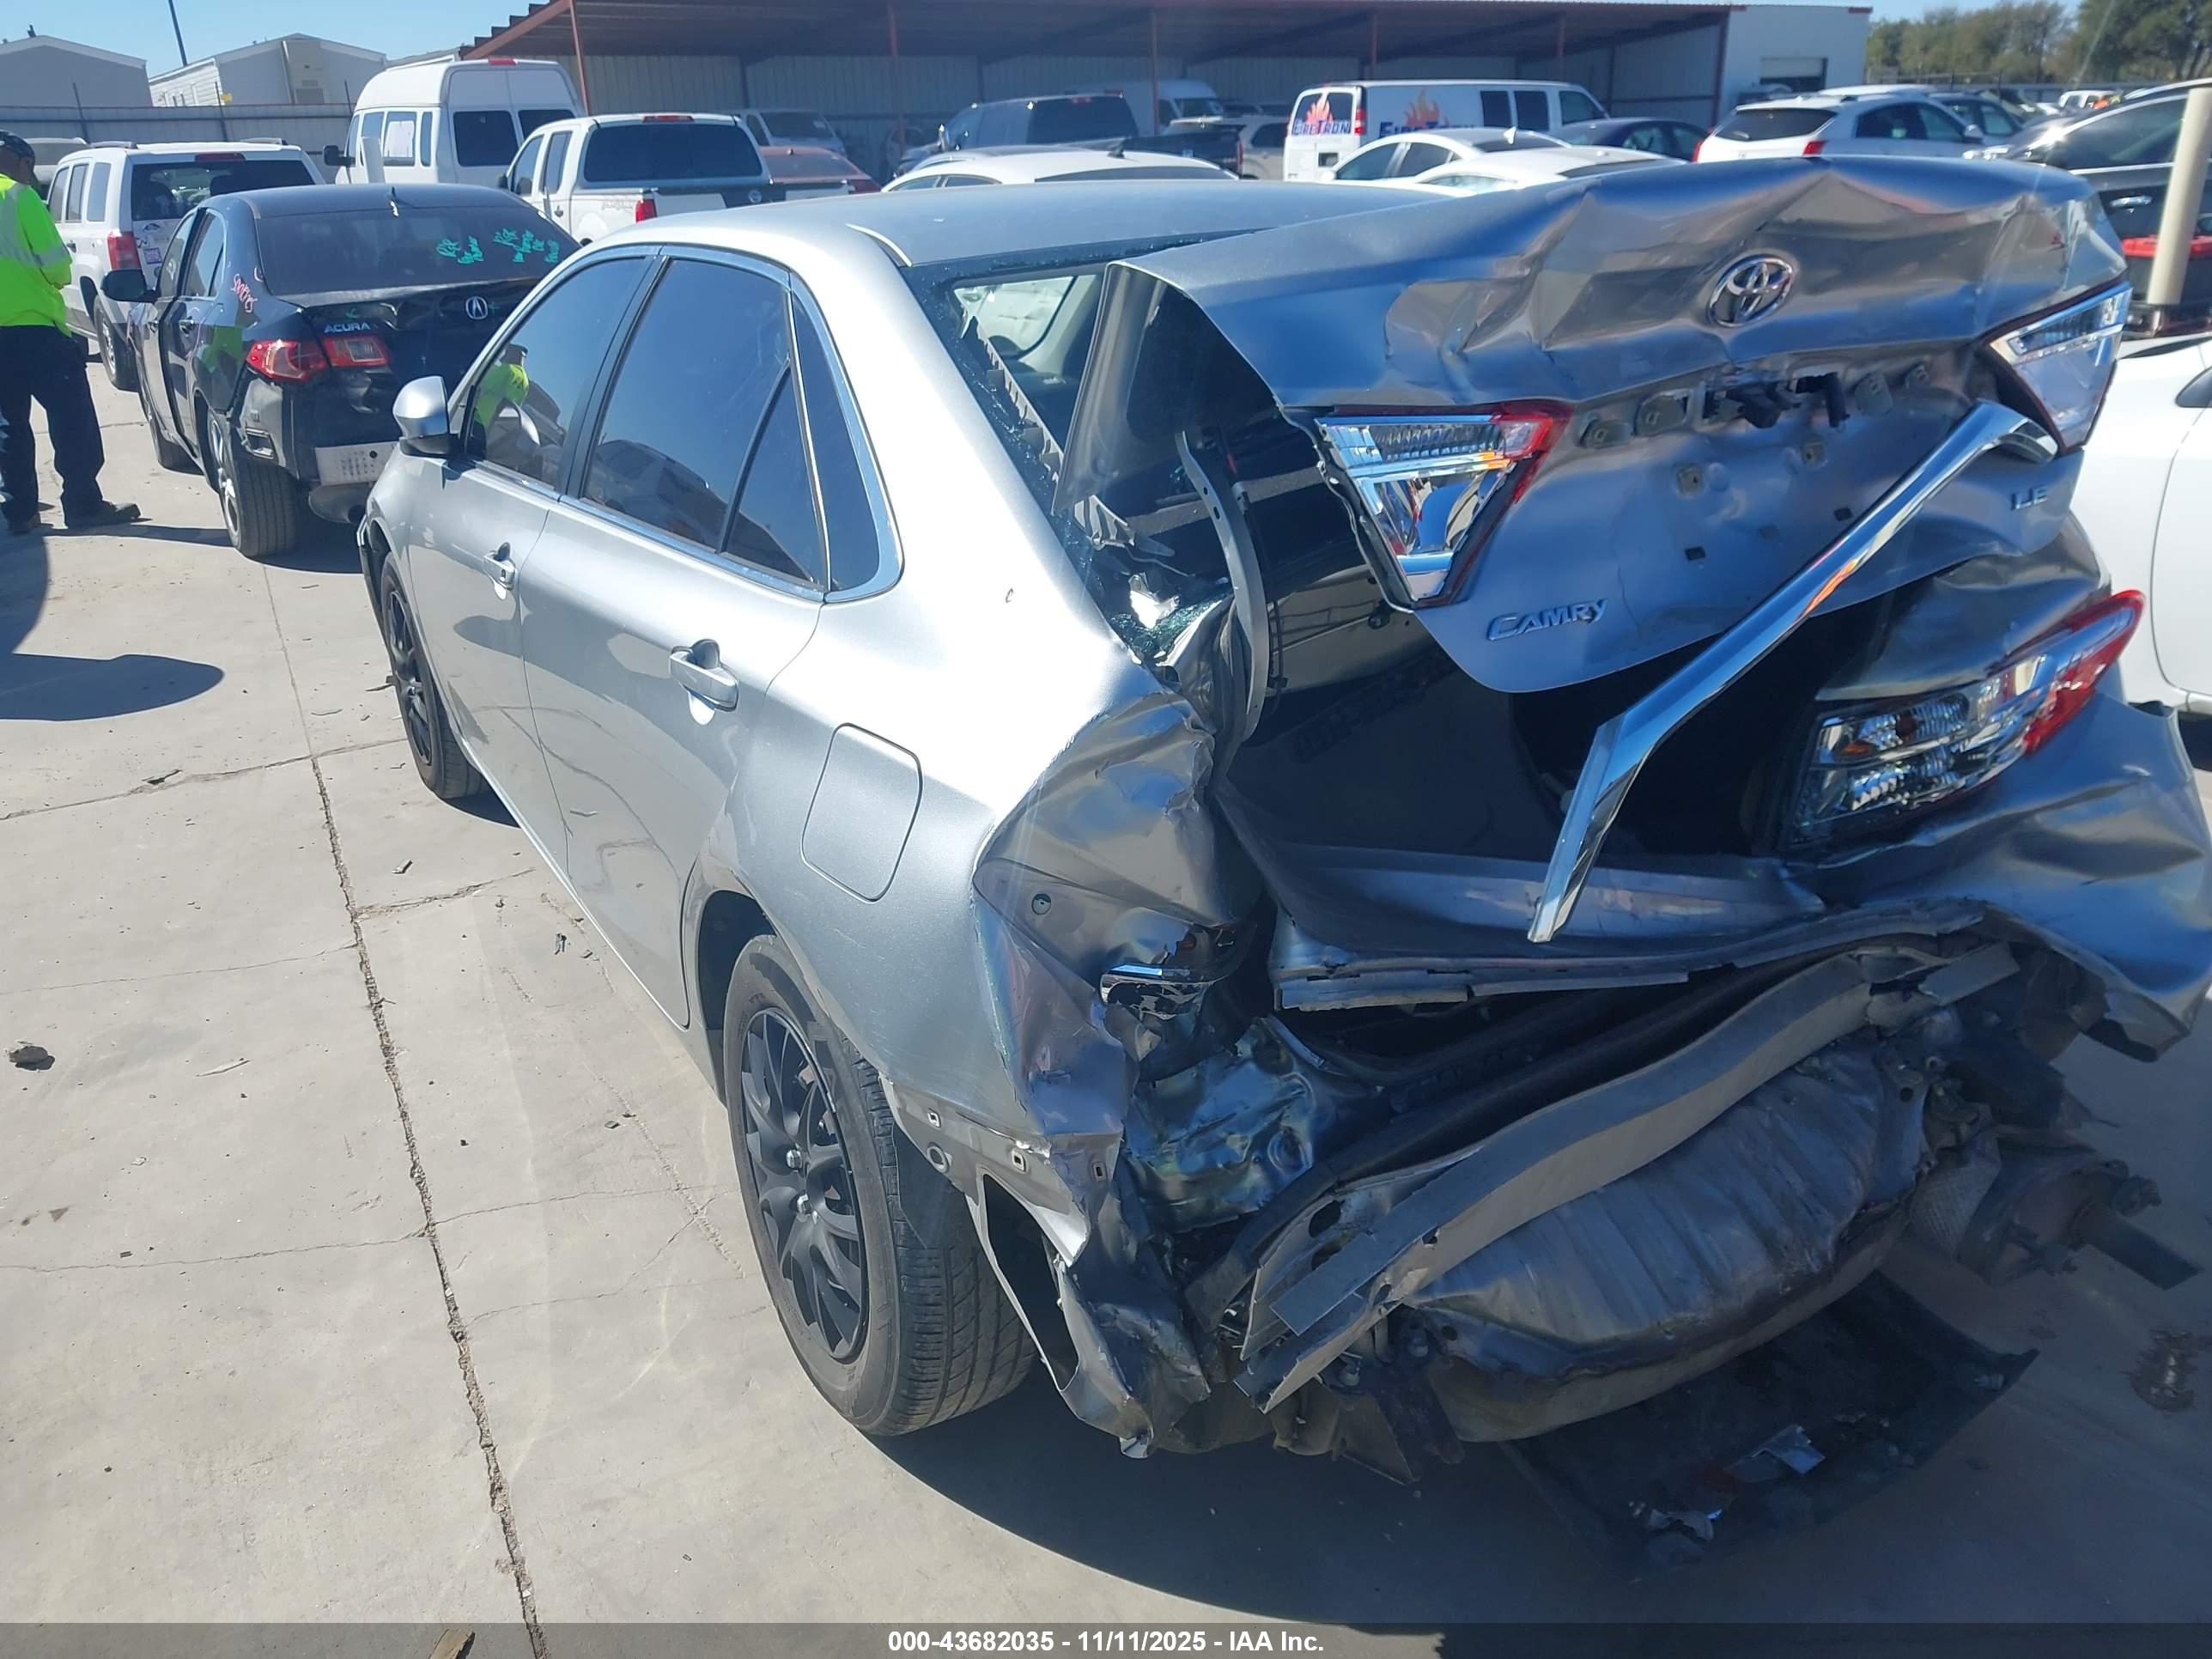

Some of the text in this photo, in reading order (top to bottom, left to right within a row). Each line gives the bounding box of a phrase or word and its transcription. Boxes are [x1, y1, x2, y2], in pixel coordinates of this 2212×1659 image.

[324, 322, 372, 333] ACURA
[2010, 487, 2048, 511] LE
[1486, 598, 1608, 641] CAMRY
